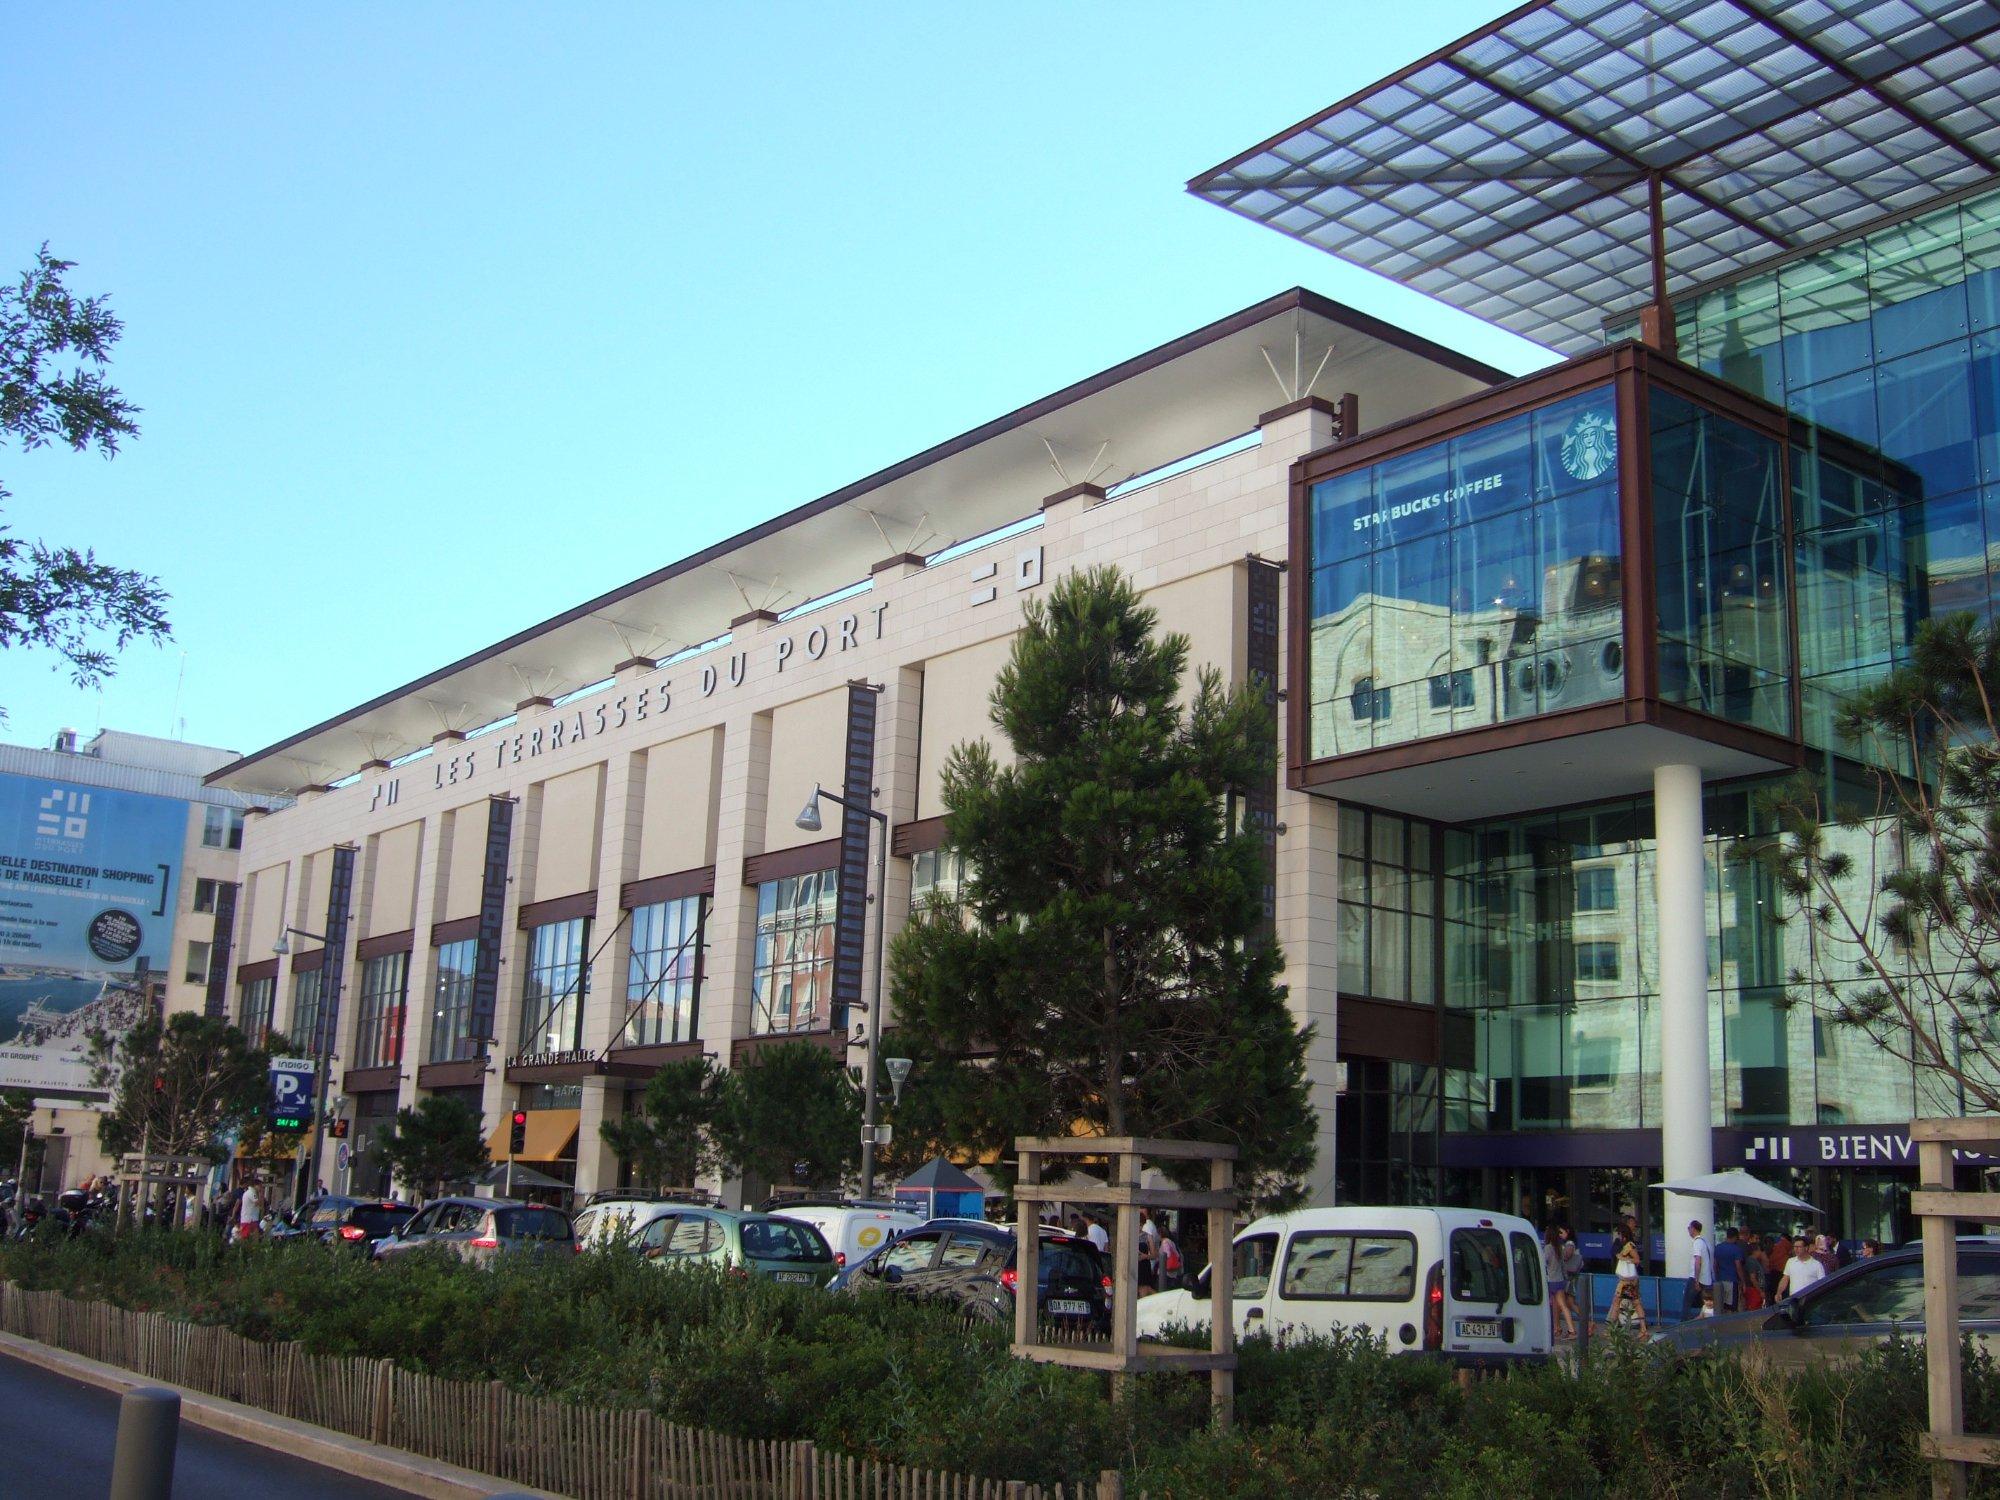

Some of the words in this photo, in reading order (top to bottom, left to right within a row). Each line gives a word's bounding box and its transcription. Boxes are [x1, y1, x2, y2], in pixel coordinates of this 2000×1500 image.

[1353, 493, 1441, 531] STARBUCKS
[1443, 473, 1504, 504] COFFEE
[434, 750, 476, 790] LES
[494, 680, 671, 769] TERRASSES
[700, 652, 747, 698] DU
[775, 601, 889, 673] PORT
[5, 869, 20, 881] DE
[22, 871, 83, 889] MARSEILLE
[30, 859, 99, 878] DESTINATION
[102, 869, 154, 885] SHOPPING
[278, 1060, 309, 1070] INDIGO
[507, 1055, 517, 1067] LA
[522, 1051, 559, 1067] GRANDE
[564, 1049, 596, 1063] HALLE
[276, 1073, 299, 1103] P
